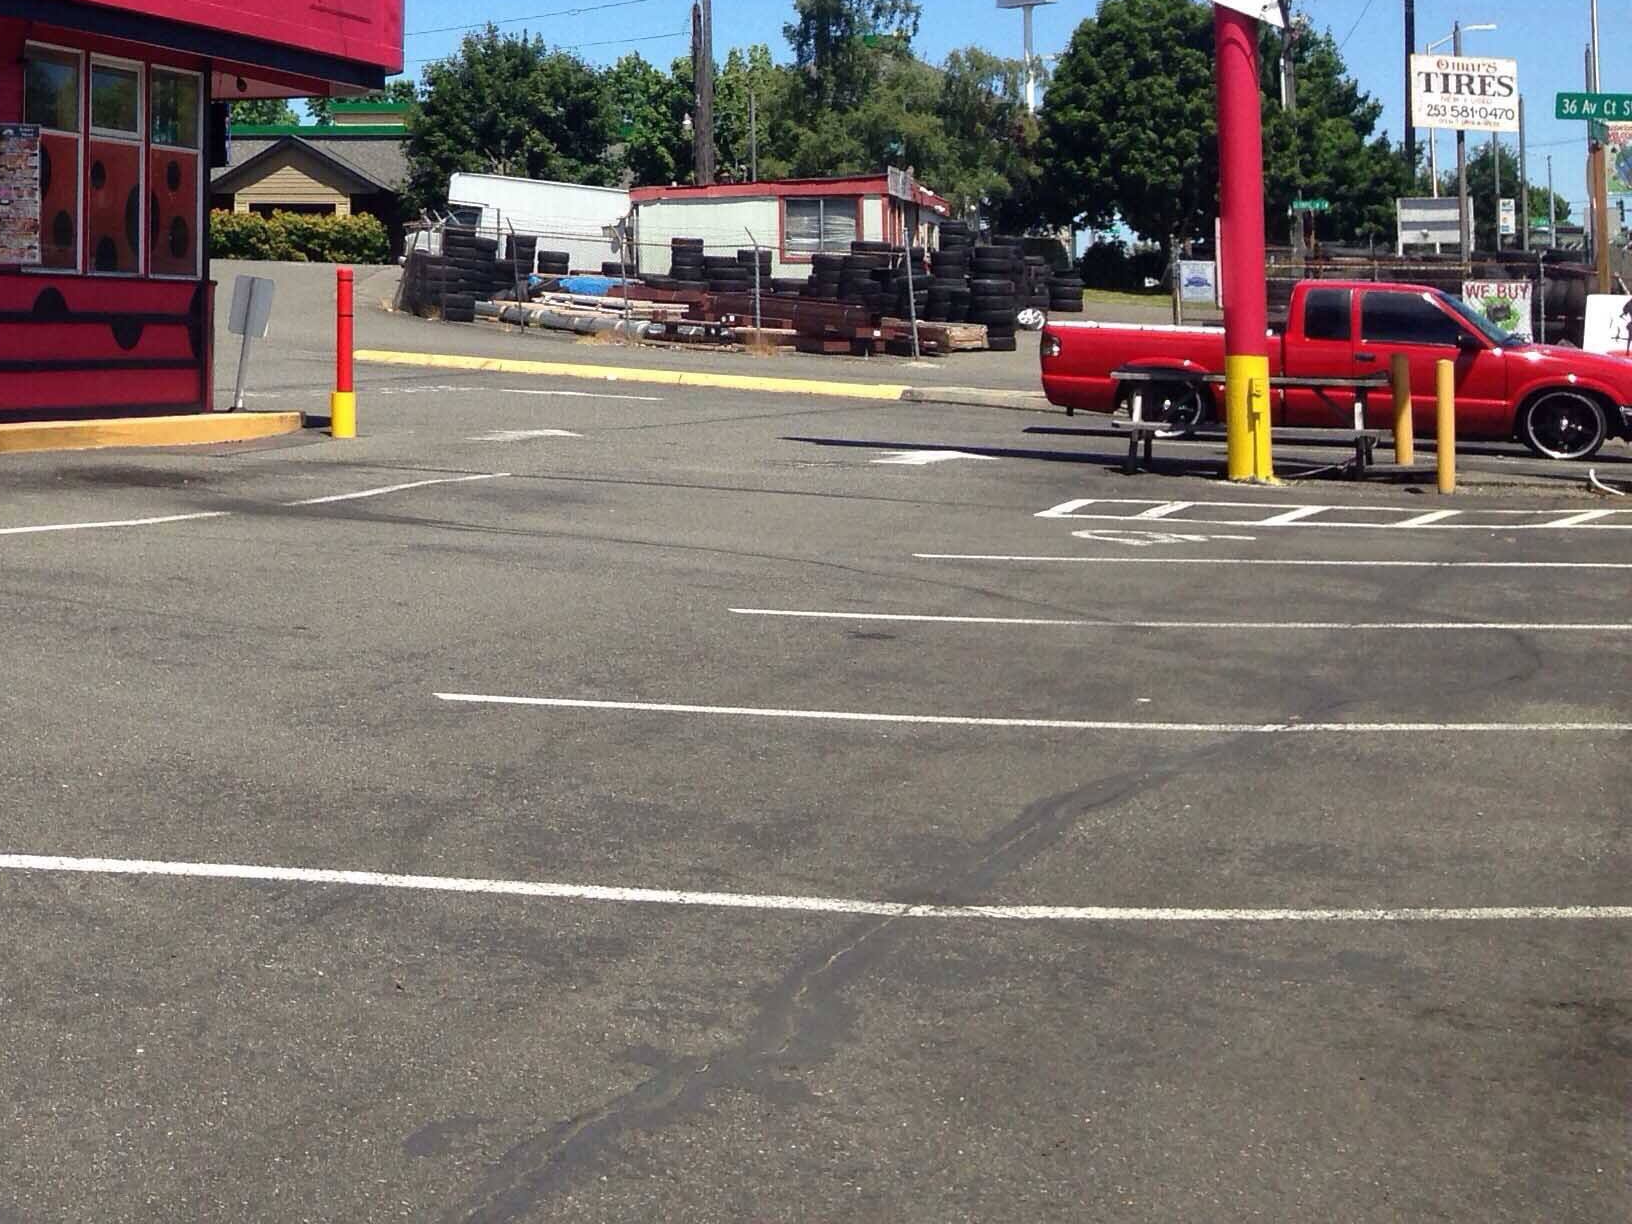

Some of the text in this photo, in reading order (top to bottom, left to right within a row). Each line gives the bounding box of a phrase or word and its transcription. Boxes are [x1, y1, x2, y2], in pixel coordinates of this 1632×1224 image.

[1417, 71, 1514, 97] TIRES
[1426, 103, 1447, 117] 253
[1562, 99, 1632, 116] 36 Av Ct S
[1466, 283, 1529, 299] WE BUY
